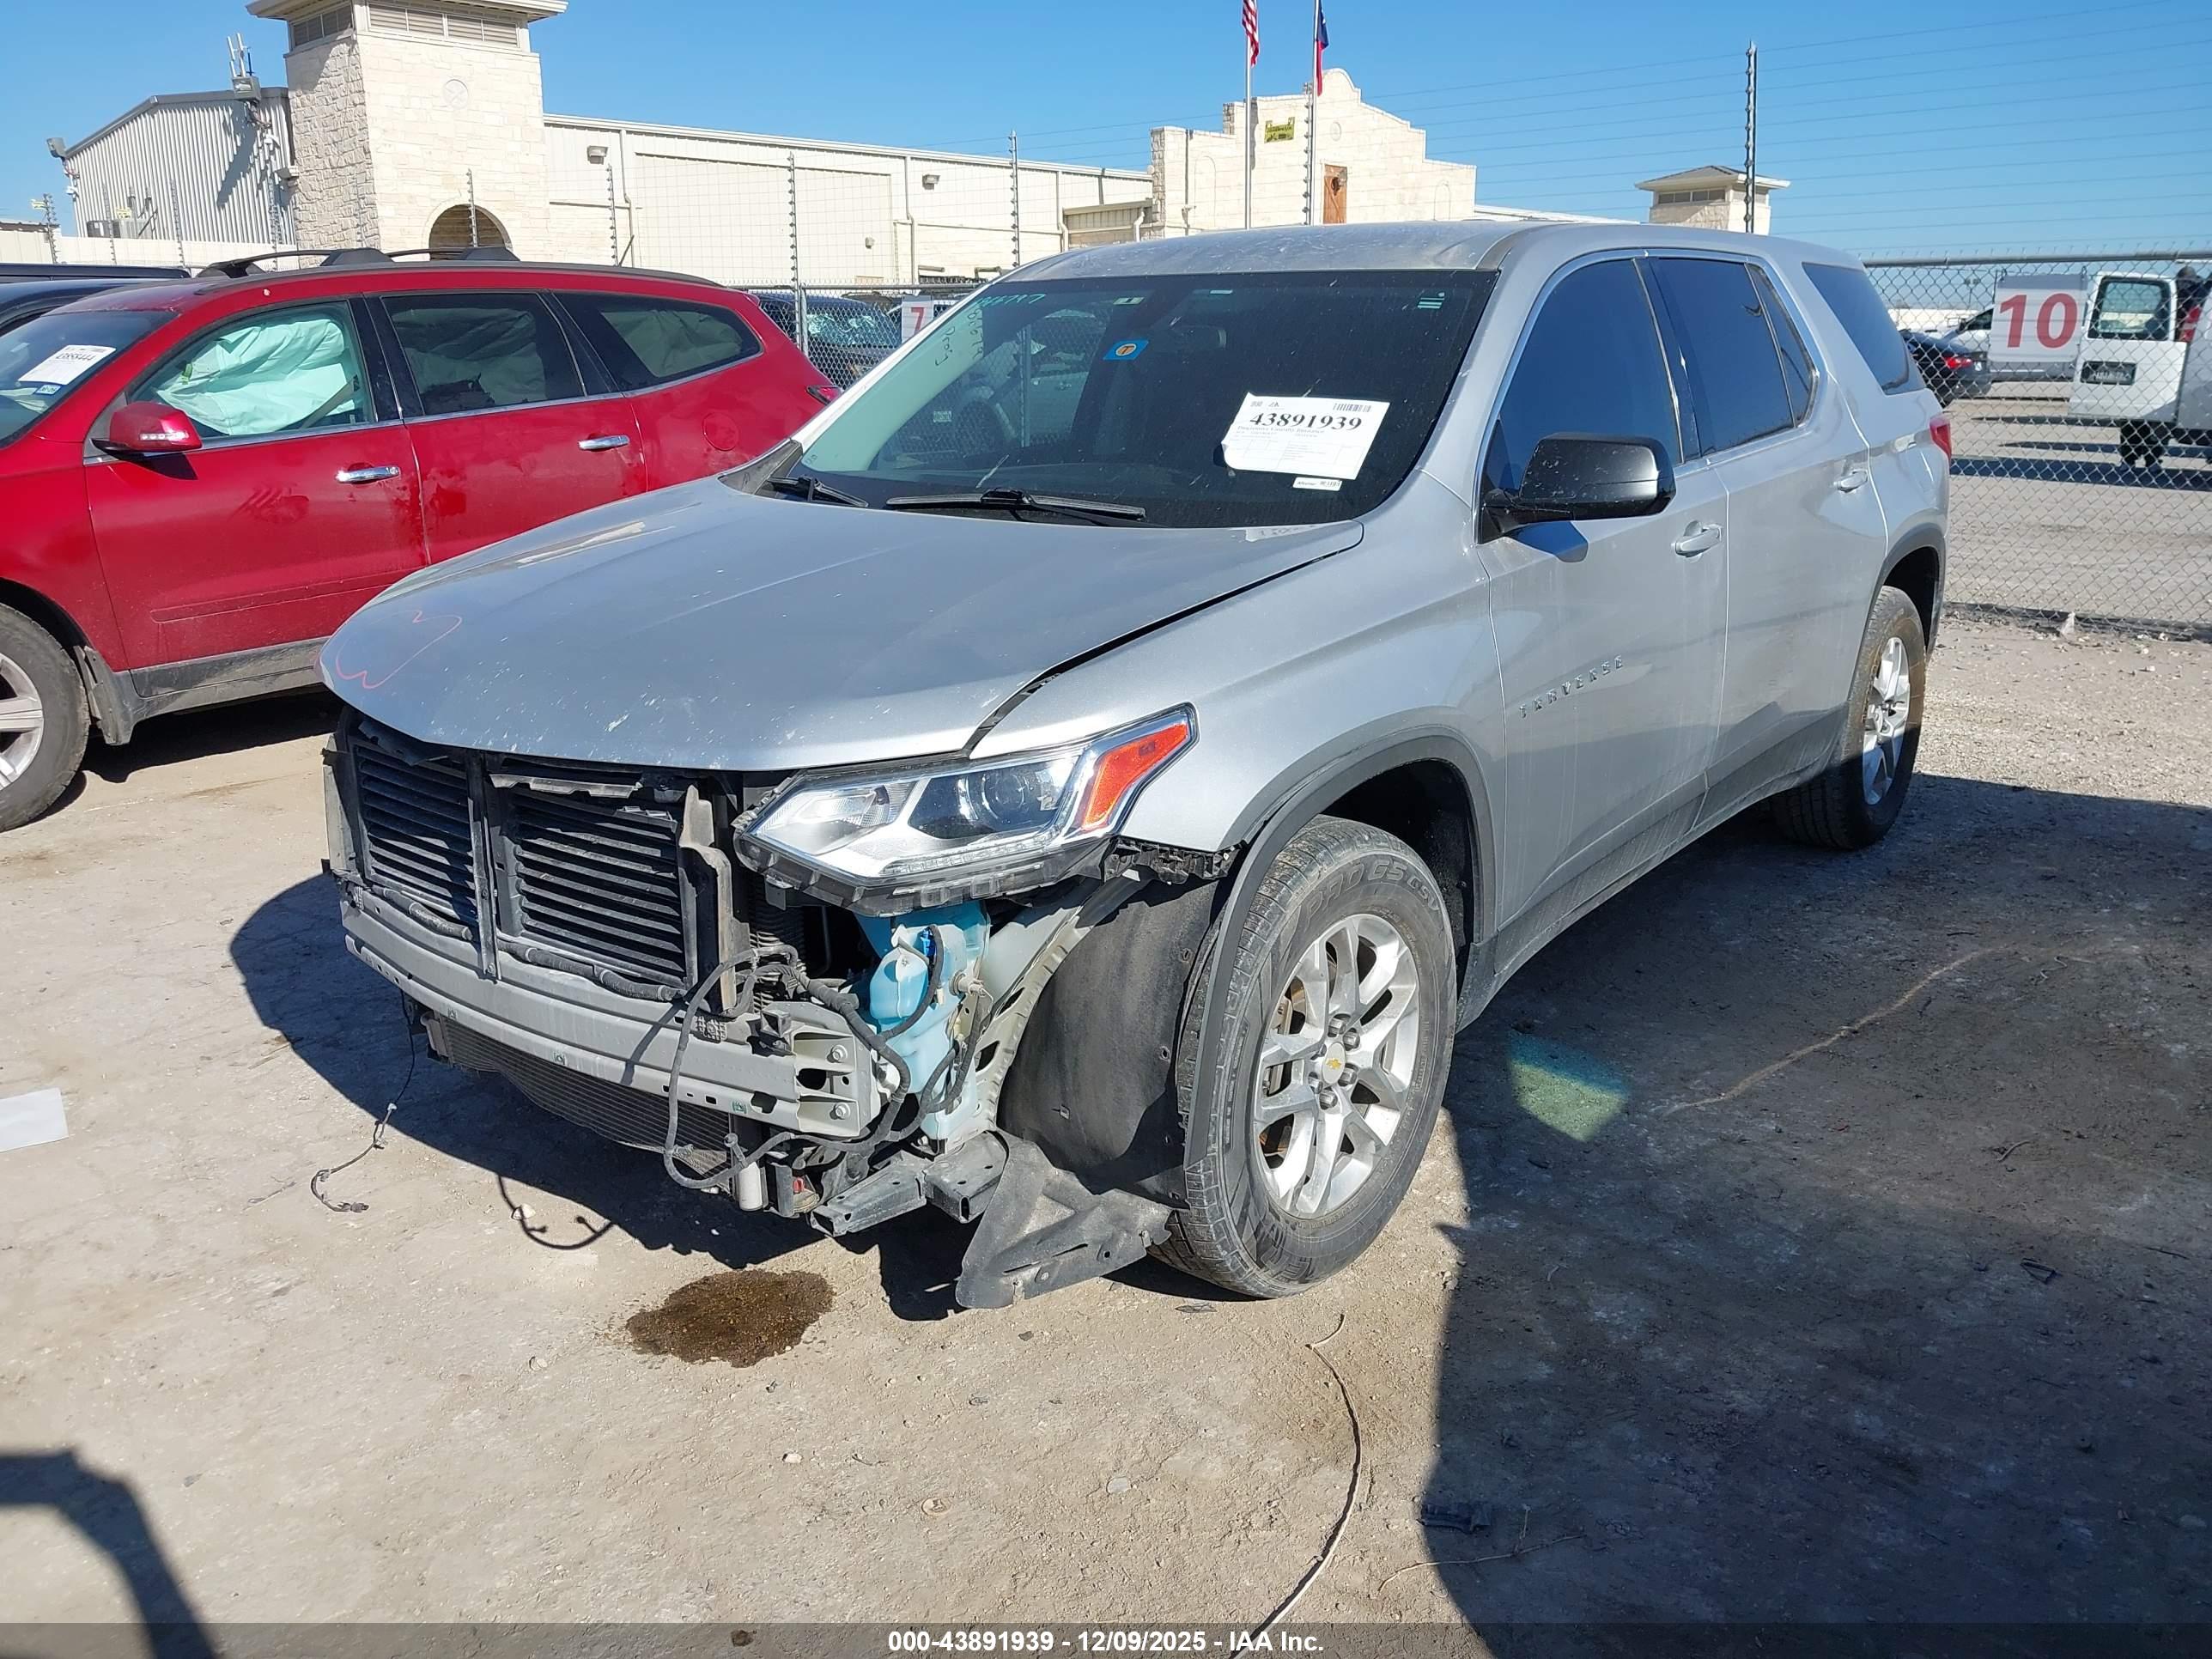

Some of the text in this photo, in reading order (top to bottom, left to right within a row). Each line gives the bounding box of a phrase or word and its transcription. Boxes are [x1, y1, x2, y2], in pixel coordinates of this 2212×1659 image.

[911, 307, 925, 335] 7
[2000, 293, 2078, 349] 10
[1249, 412, 1362, 430] 43891939
[1519, 654, 1623, 719] TRAVERSE
